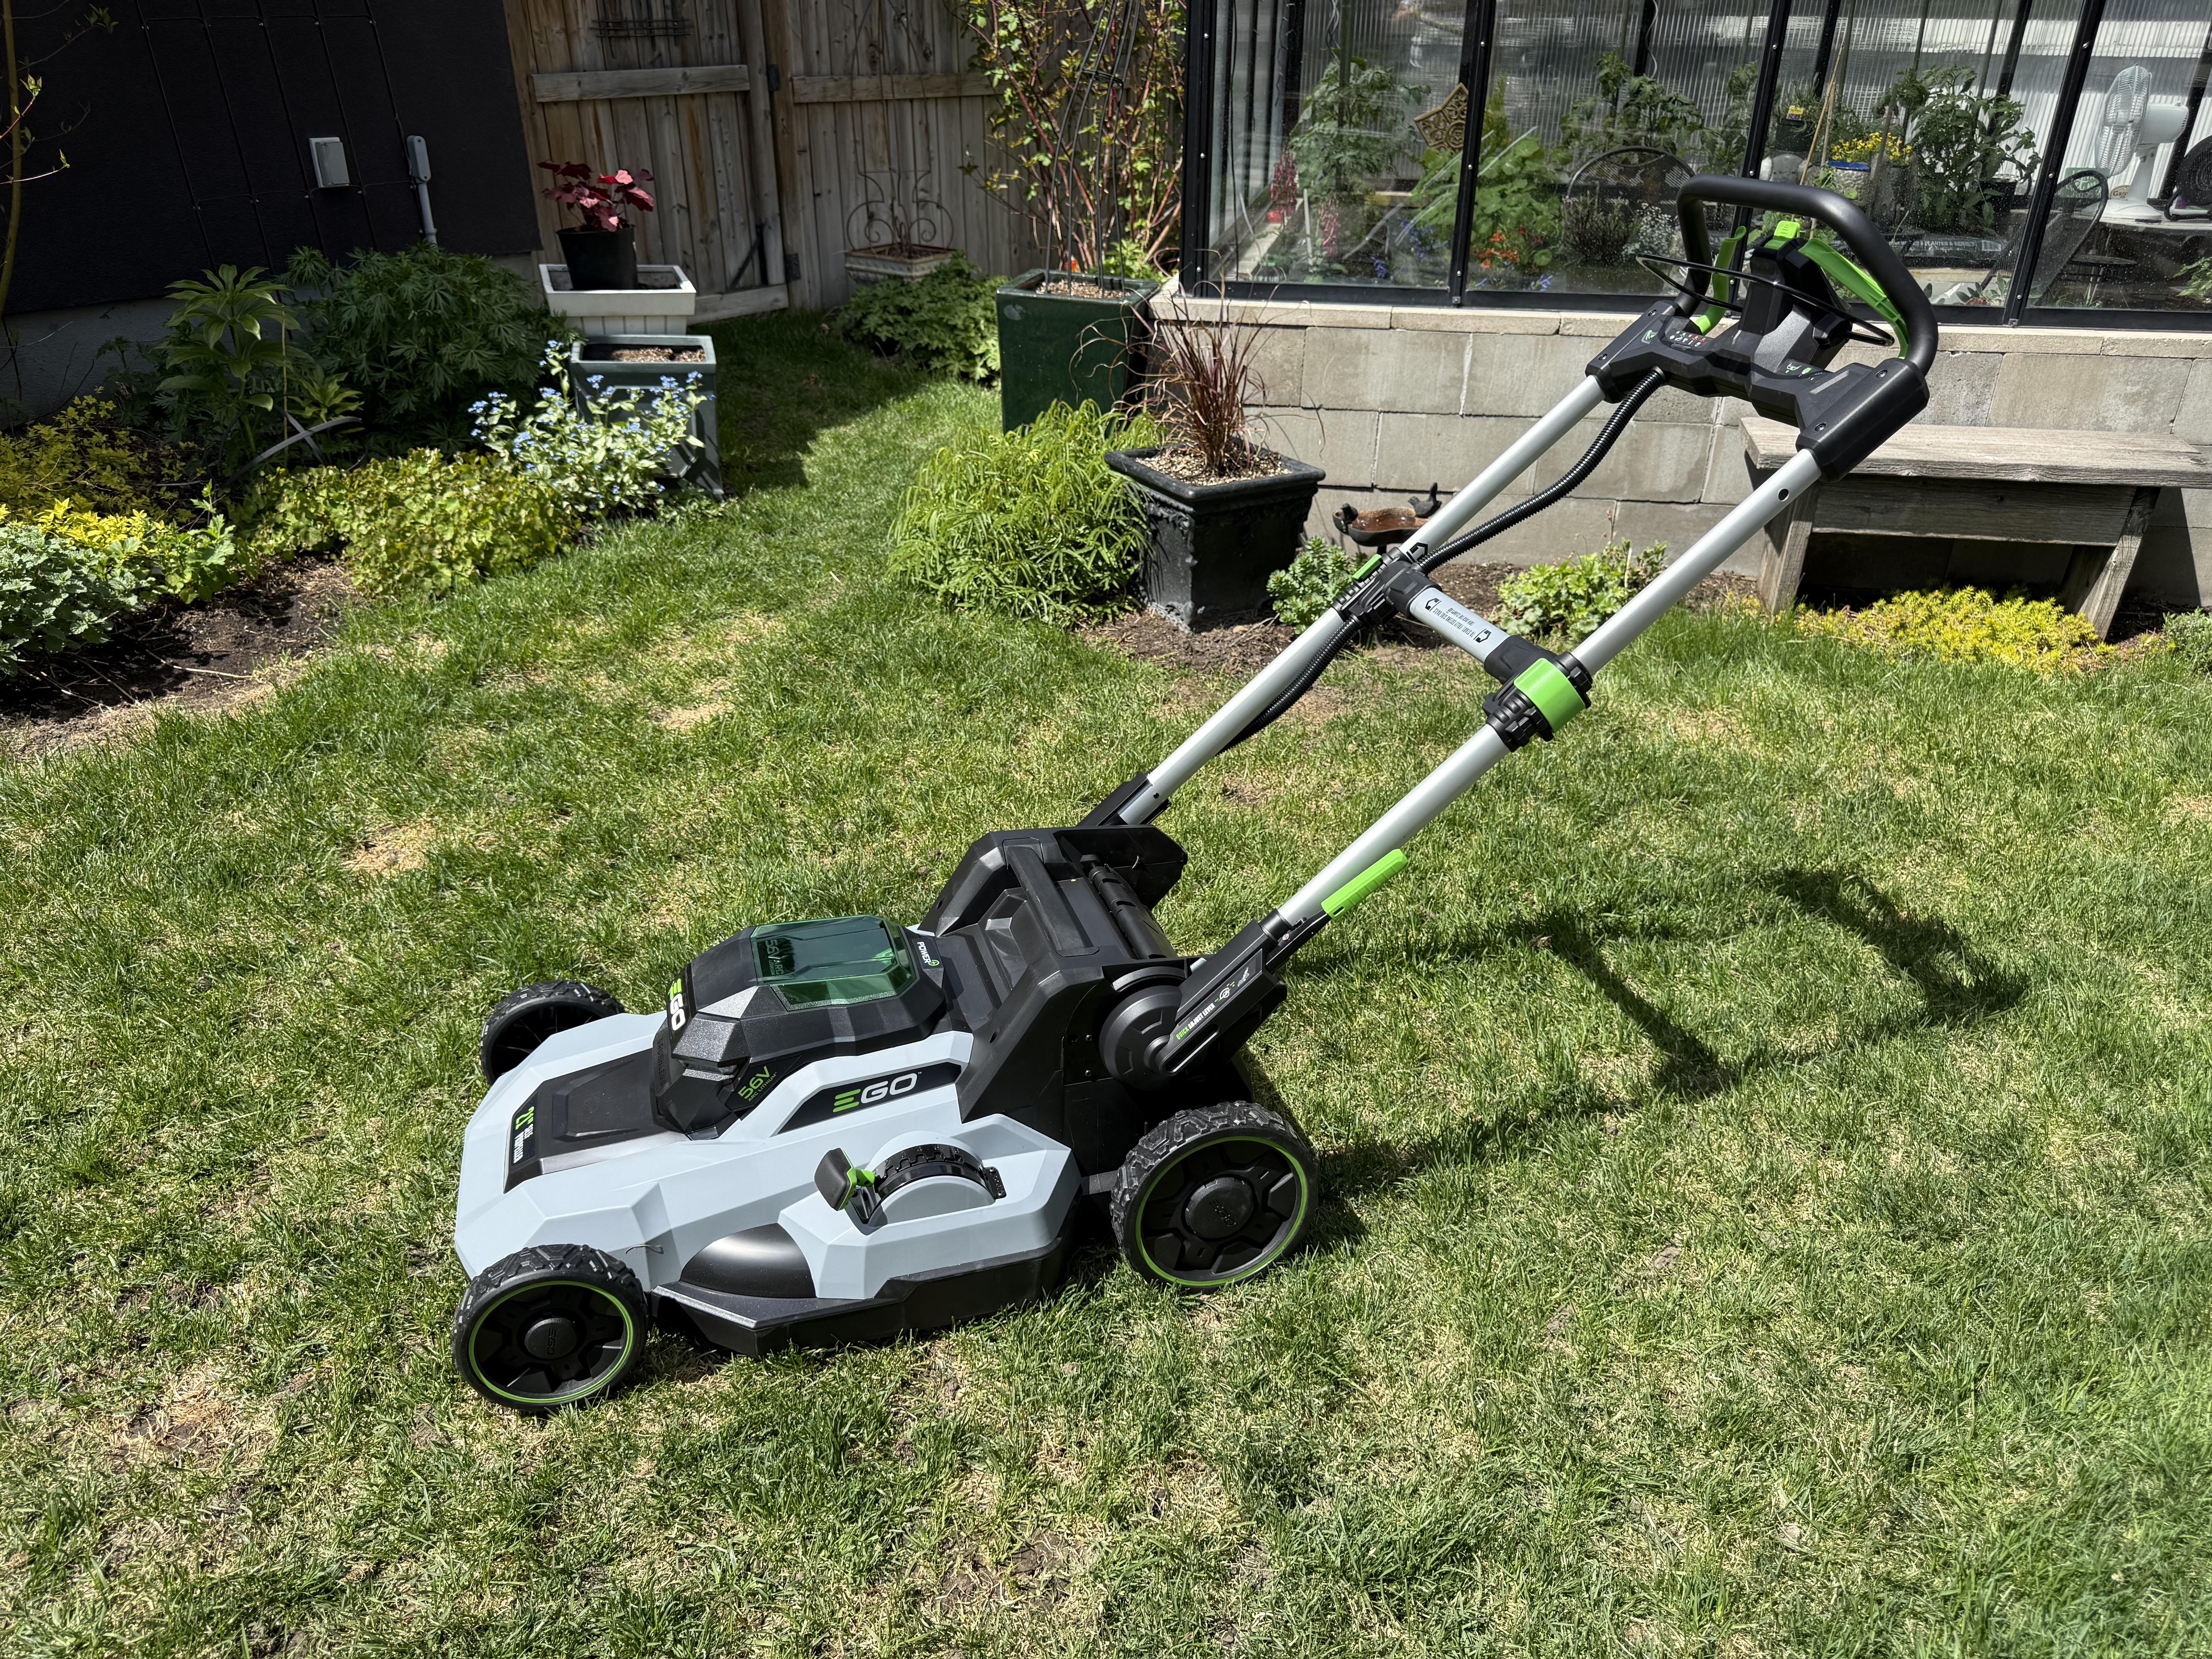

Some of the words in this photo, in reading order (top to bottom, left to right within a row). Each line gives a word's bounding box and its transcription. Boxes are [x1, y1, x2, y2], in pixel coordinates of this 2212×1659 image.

[670, 978, 686, 1030] EGO
[1176, 1026, 1189, 1040] QUICK
[1188, 1013, 1204, 1029] ADJUST
[1202, 1003, 1216, 1016] LEVER
[657, 1038, 666, 1086] BRUSHLESS
[737, 1065, 770, 1099] 56V
[748, 1092, 759, 1102] ARC
[758, 1073, 776, 1092] LITHIUM
[833, 1073, 917, 1113] EGO
[547, 1328, 557, 1355] EGO
